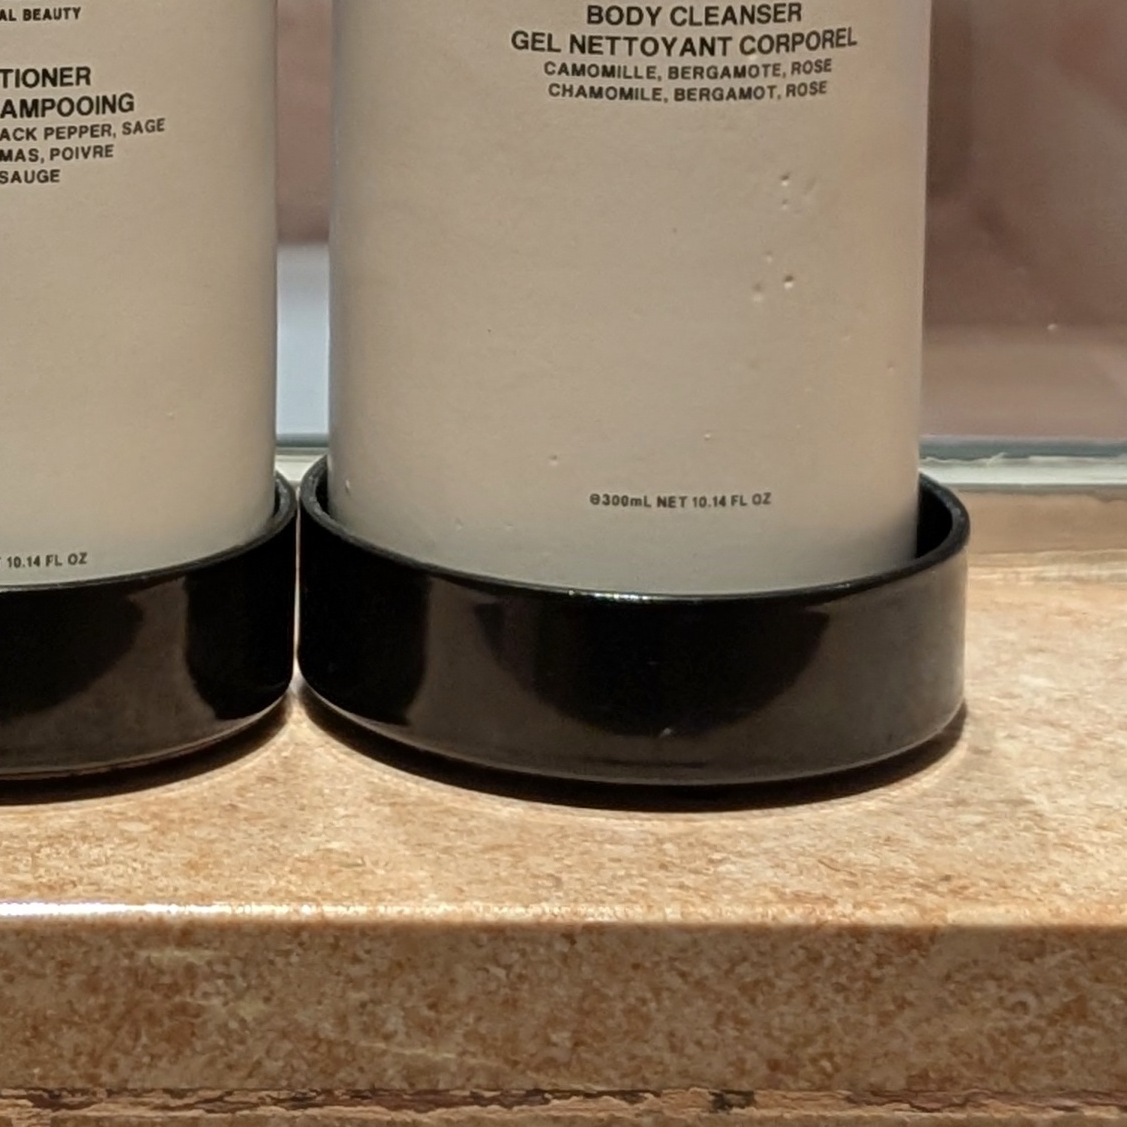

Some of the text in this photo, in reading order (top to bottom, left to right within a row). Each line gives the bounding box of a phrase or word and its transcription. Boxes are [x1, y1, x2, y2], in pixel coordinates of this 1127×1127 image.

[22, 7, 81, 21] BEAUTY
[586, 3, 802, 26] BODY CLEANSER
[511, 26, 858, 56] GEL NETTOYANT CORPOREL
[544, 59, 832, 81] CAMOMILLE, BERGAMOTE, ROSE
[548, 81, 827, 102] CHAMOMILE, BERGAMOT, ROSE
[44, 123, 117, 140] PEPPER,
[122, 118, 165, 135] SAGE
[50, 145, 114, 161] POIVRE
[657, 495, 687, 508] NET
[692, 496, 726, 508] 10.14
[731, 495, 747, 506] FL
[752, 492, 772, 505] OZ
[7, 555, 41, 568] 10.14
[46, 555, 62, 567] FL
[68, 552, 88, 565] OZ
